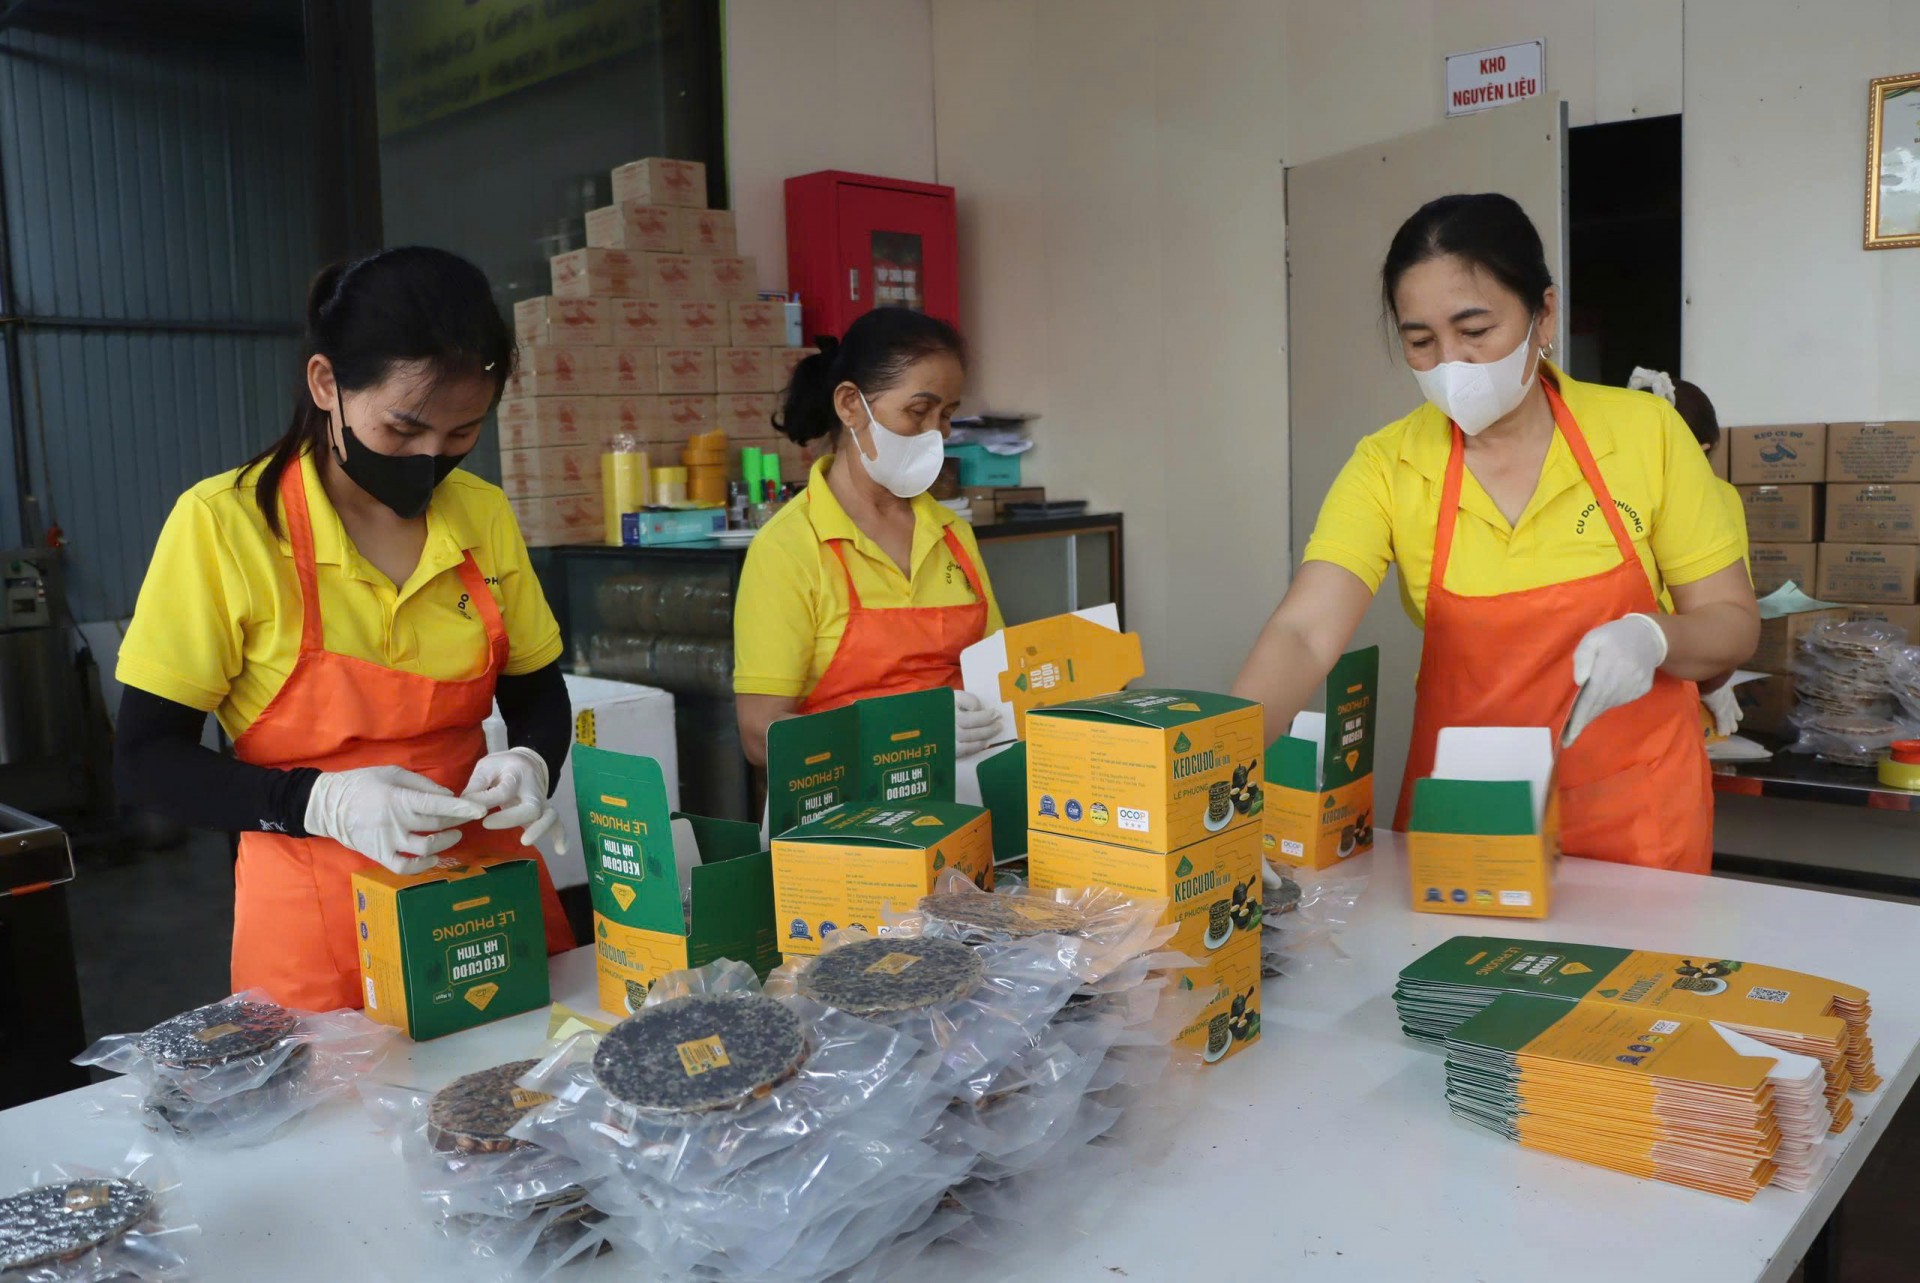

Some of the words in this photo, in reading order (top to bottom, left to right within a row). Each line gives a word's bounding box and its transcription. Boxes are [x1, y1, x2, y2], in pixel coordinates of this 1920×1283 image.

[1480, 56, 1506, 75] KHO
[1453, 82, 1504, 107] NGUYÊN
[1508, 77, 1536, 100] LIỆU
[1576, 520, 1585, 534] CU
[1581, 504, 1595, 518] DO
[1120, 809, 1147, 821] OCOP
